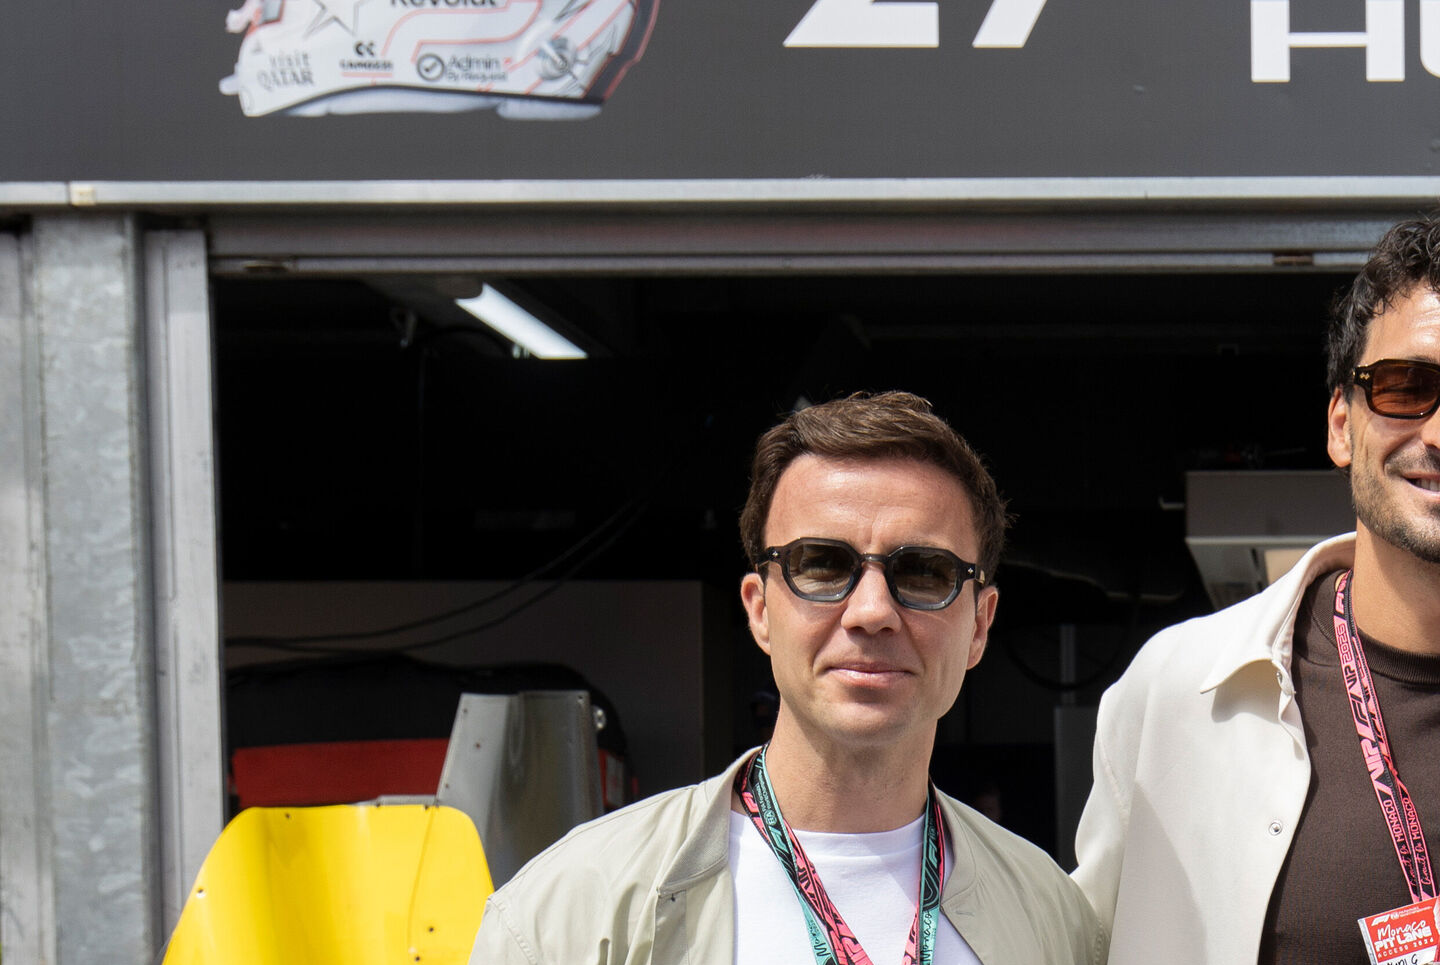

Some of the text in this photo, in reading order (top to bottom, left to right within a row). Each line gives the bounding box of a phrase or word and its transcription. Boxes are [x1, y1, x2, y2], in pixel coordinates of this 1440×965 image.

[1383, 799, 1405, 843] MONACO
[1402, 797, 1421, 840] MONACO
[1374, 936, 1396, 952] PIT
